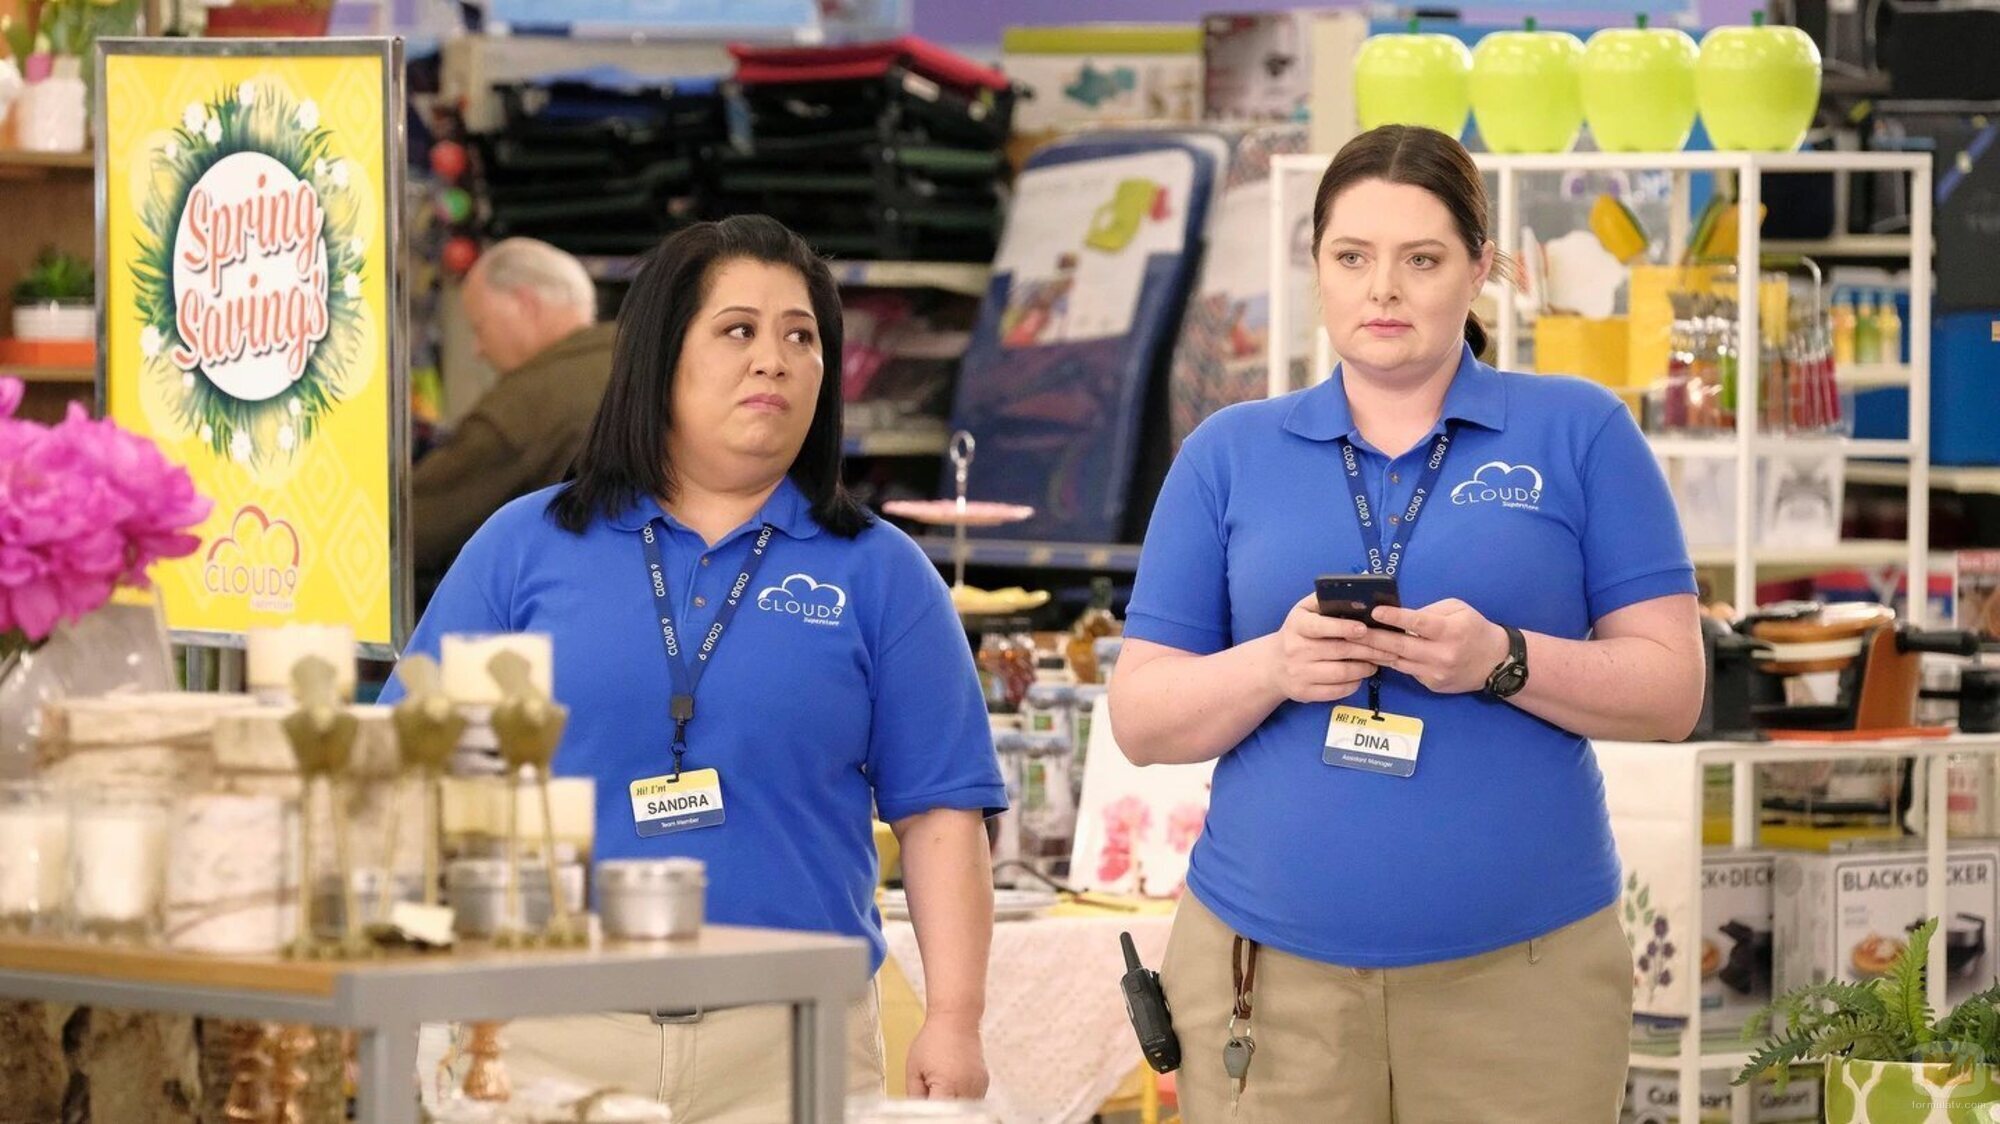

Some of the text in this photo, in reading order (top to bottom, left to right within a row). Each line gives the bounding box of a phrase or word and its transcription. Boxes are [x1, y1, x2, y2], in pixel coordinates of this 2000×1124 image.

[183, 173, 318, 290] Spring
[174, 270, 326, 374] Savings
[1343, 445, 1356, 471] CLOUD
[1428, 443, 1447, 470] CLOUD
[1355, 494, 1370, 520] CLOUD
[1404, 495, 1423, 522] CLOUD
[756, 526, 772, 547] LOUD
[1368, 548, 1383, 574] CLOU
[1385, 552, 1399, 575] OUD
[652, 570, 666, 597] CLOUD
[731, 572, 750, 598] CLOUD
[664, 625, 678, 656] CLOUD
[702, 622, 723, 652] CLOUD
[1335, 712, 1368, 726] Hi! I'm
[1354, 733, 1390, 751] DINA
[635, 784, 667, 796] Hi! I'm
[647, 794, 709, 815] SANDRA
